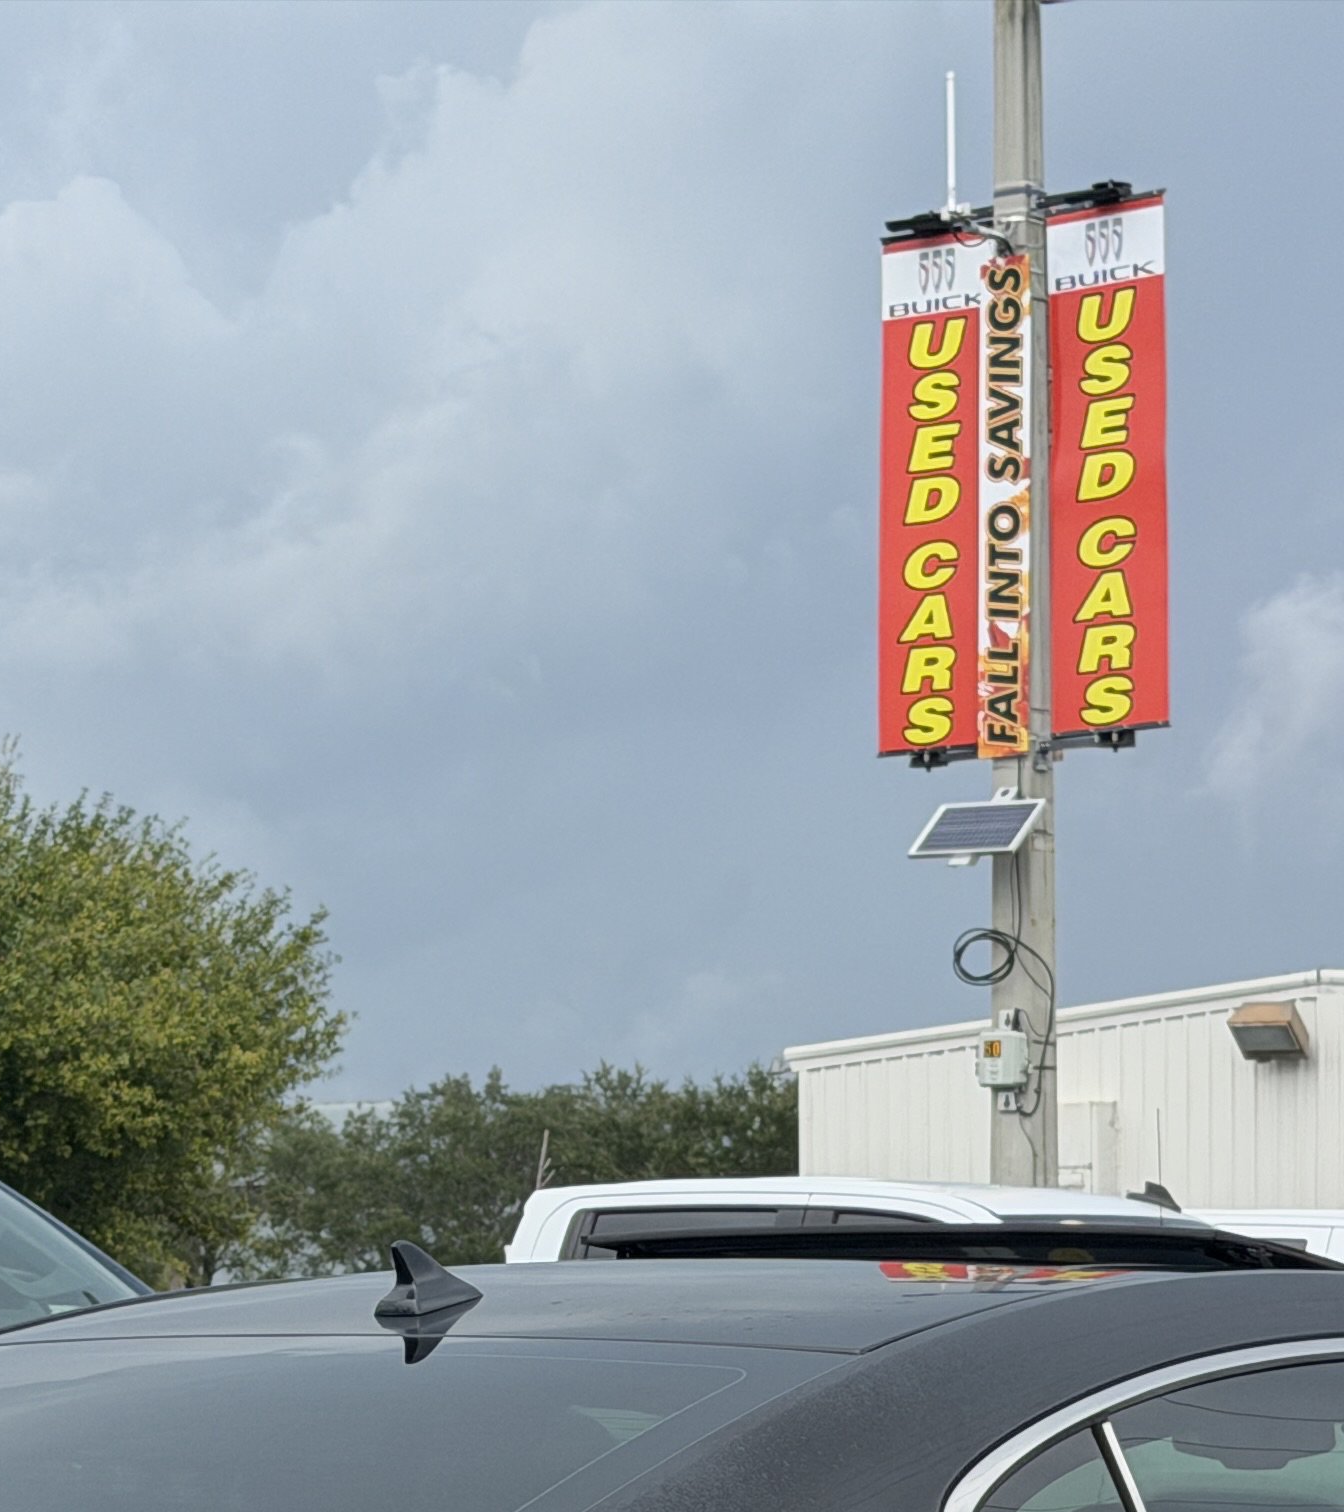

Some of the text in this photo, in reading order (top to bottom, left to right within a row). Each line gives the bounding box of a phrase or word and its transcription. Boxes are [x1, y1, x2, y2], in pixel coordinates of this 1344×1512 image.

[889, 293, 981, 318] BUICK
[1055, 260, 1155, 291] BUICK
[897, 316, 968, 746] USED CARS
[983, 266, 1023, 746] FALL INTO SAVINGS
[1072, 286, 1138, 726] USED CARS
